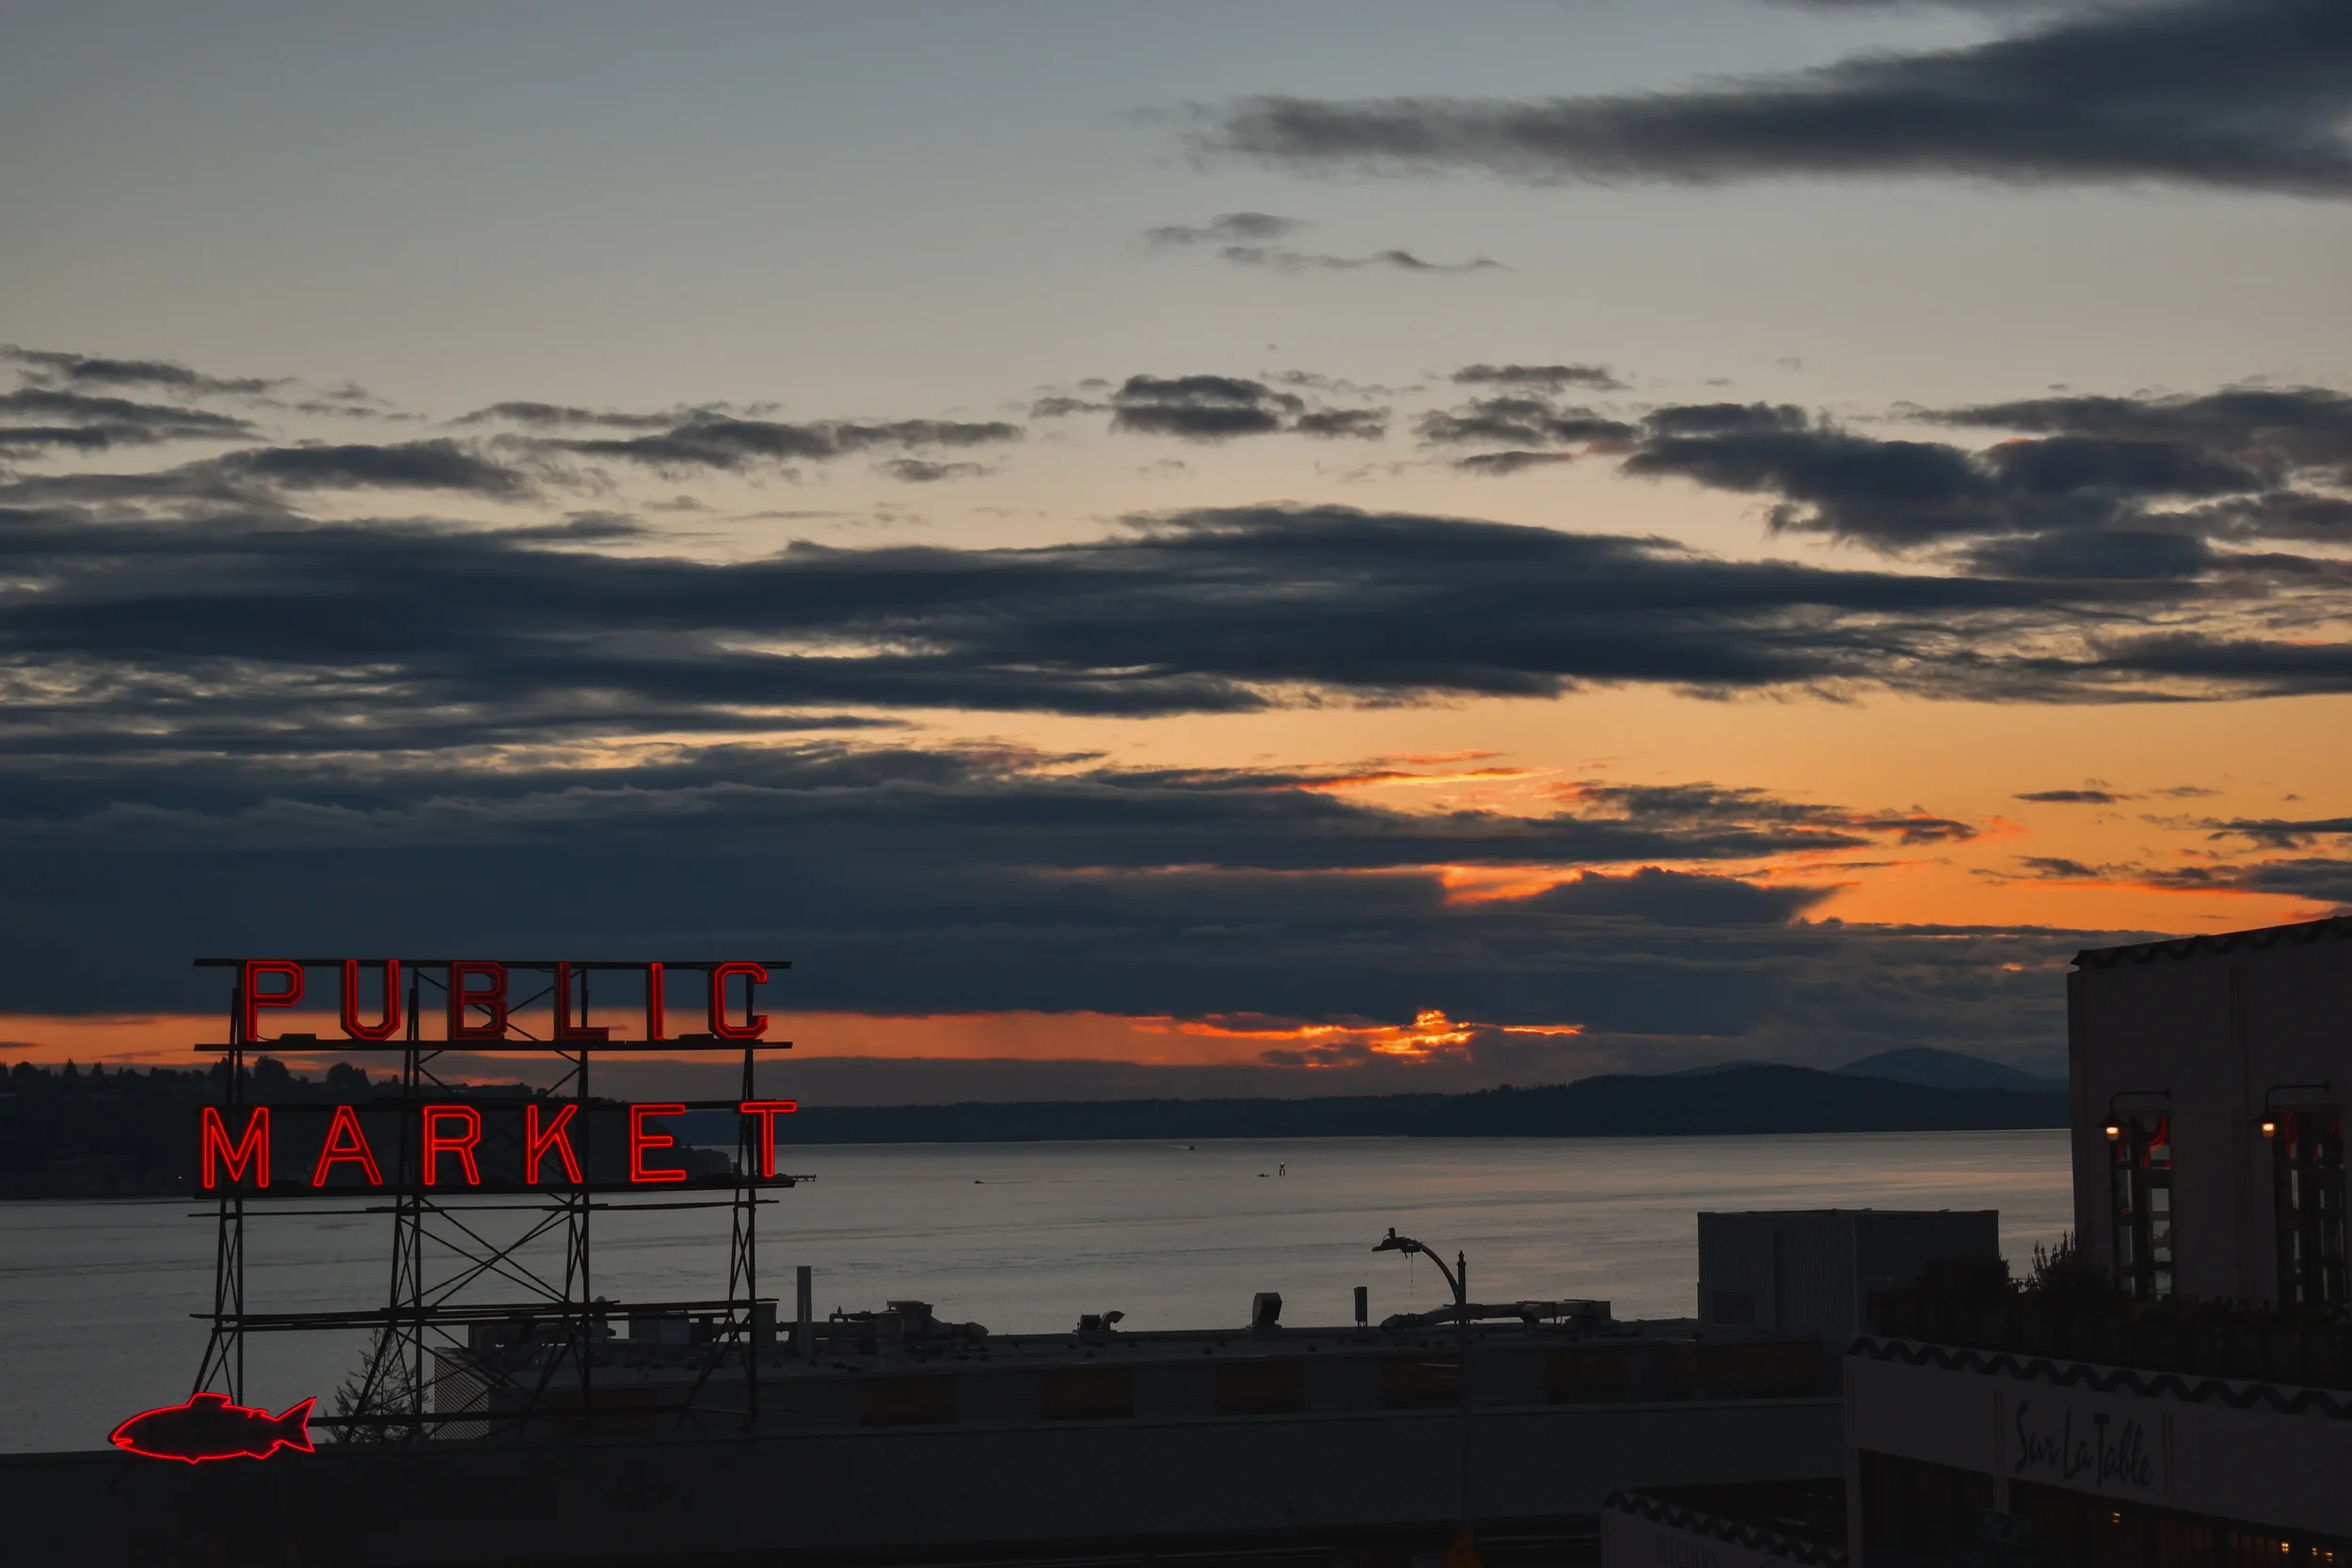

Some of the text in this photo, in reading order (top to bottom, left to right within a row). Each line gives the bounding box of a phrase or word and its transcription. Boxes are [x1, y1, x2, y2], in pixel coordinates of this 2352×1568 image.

[242, 959, 770, 1042] PUBLIC
[201, 1101, 799, 1189] MARKET
[2015, 1399, 2155, 1488] Sur La Table
